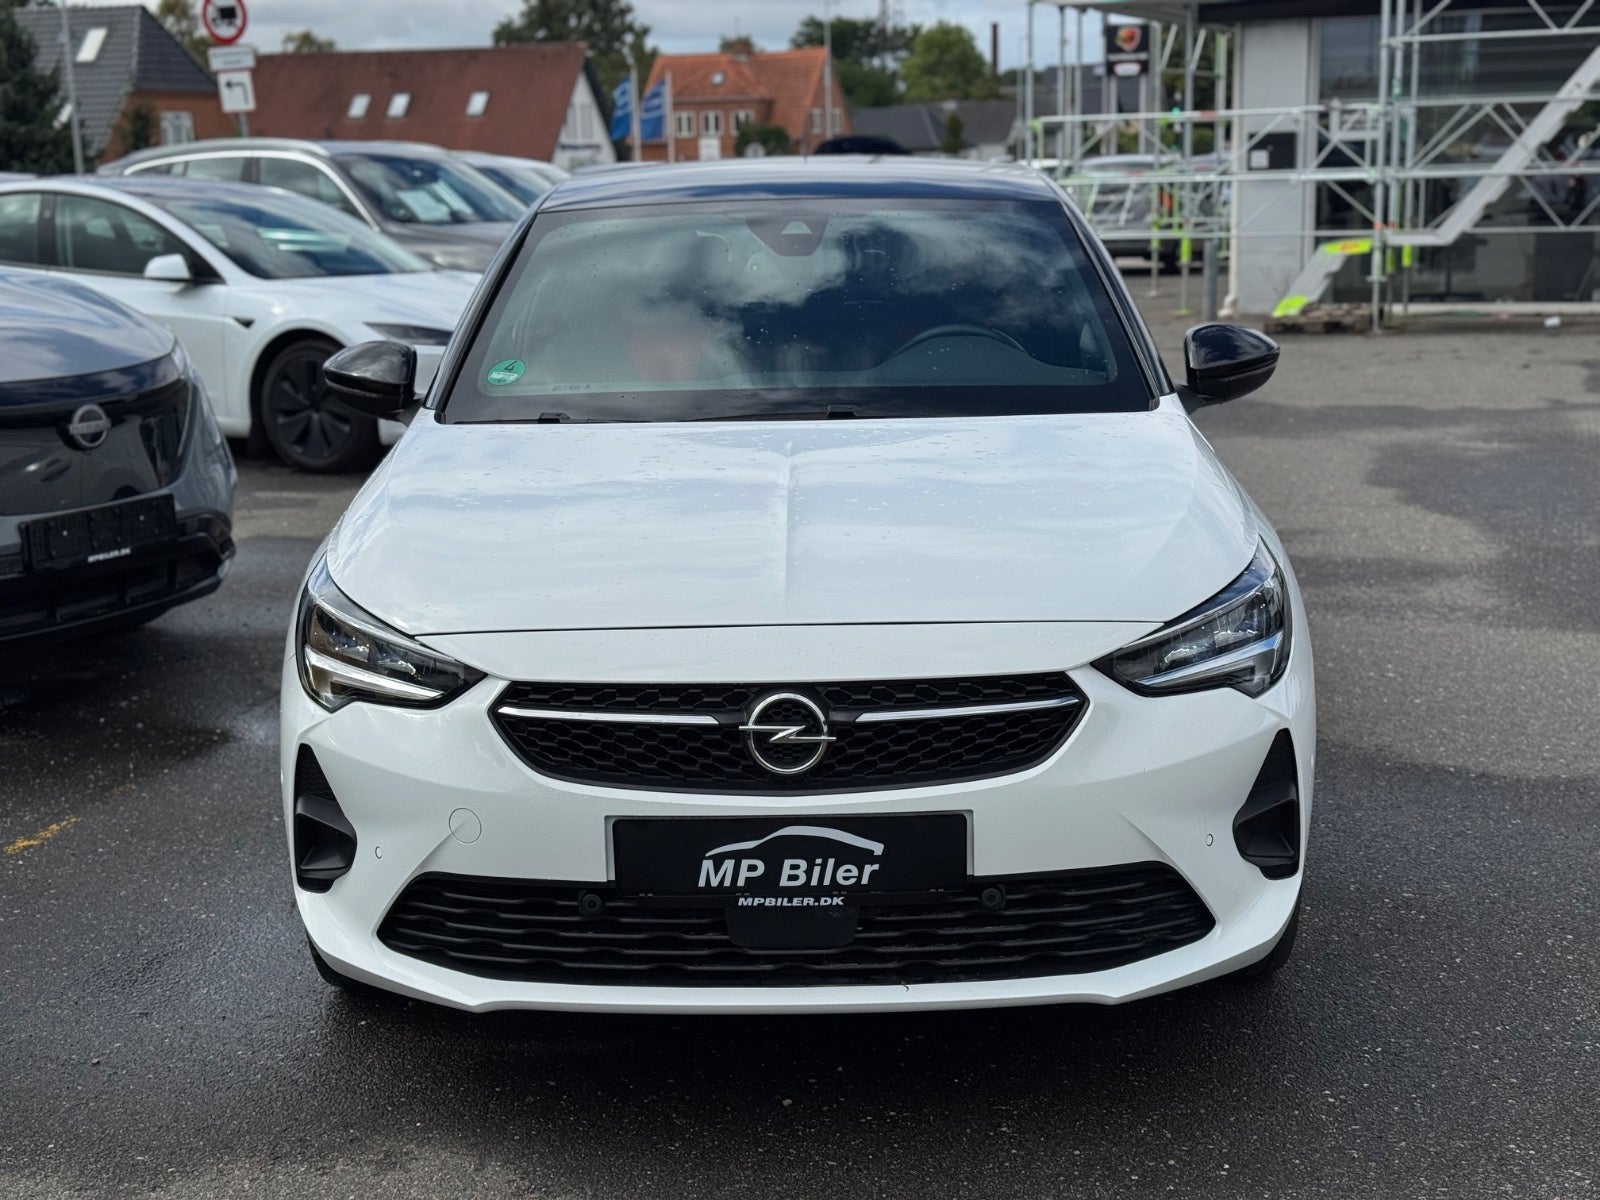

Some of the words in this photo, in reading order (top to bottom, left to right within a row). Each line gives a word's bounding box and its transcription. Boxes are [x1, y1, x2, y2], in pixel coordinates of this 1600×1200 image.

[504, 361, 518, 372] 4
[698, 858, 765, 888] MP
[779, 857, 880, 887] Biler
[737, 896, 845, 907] MPBILER.DK
